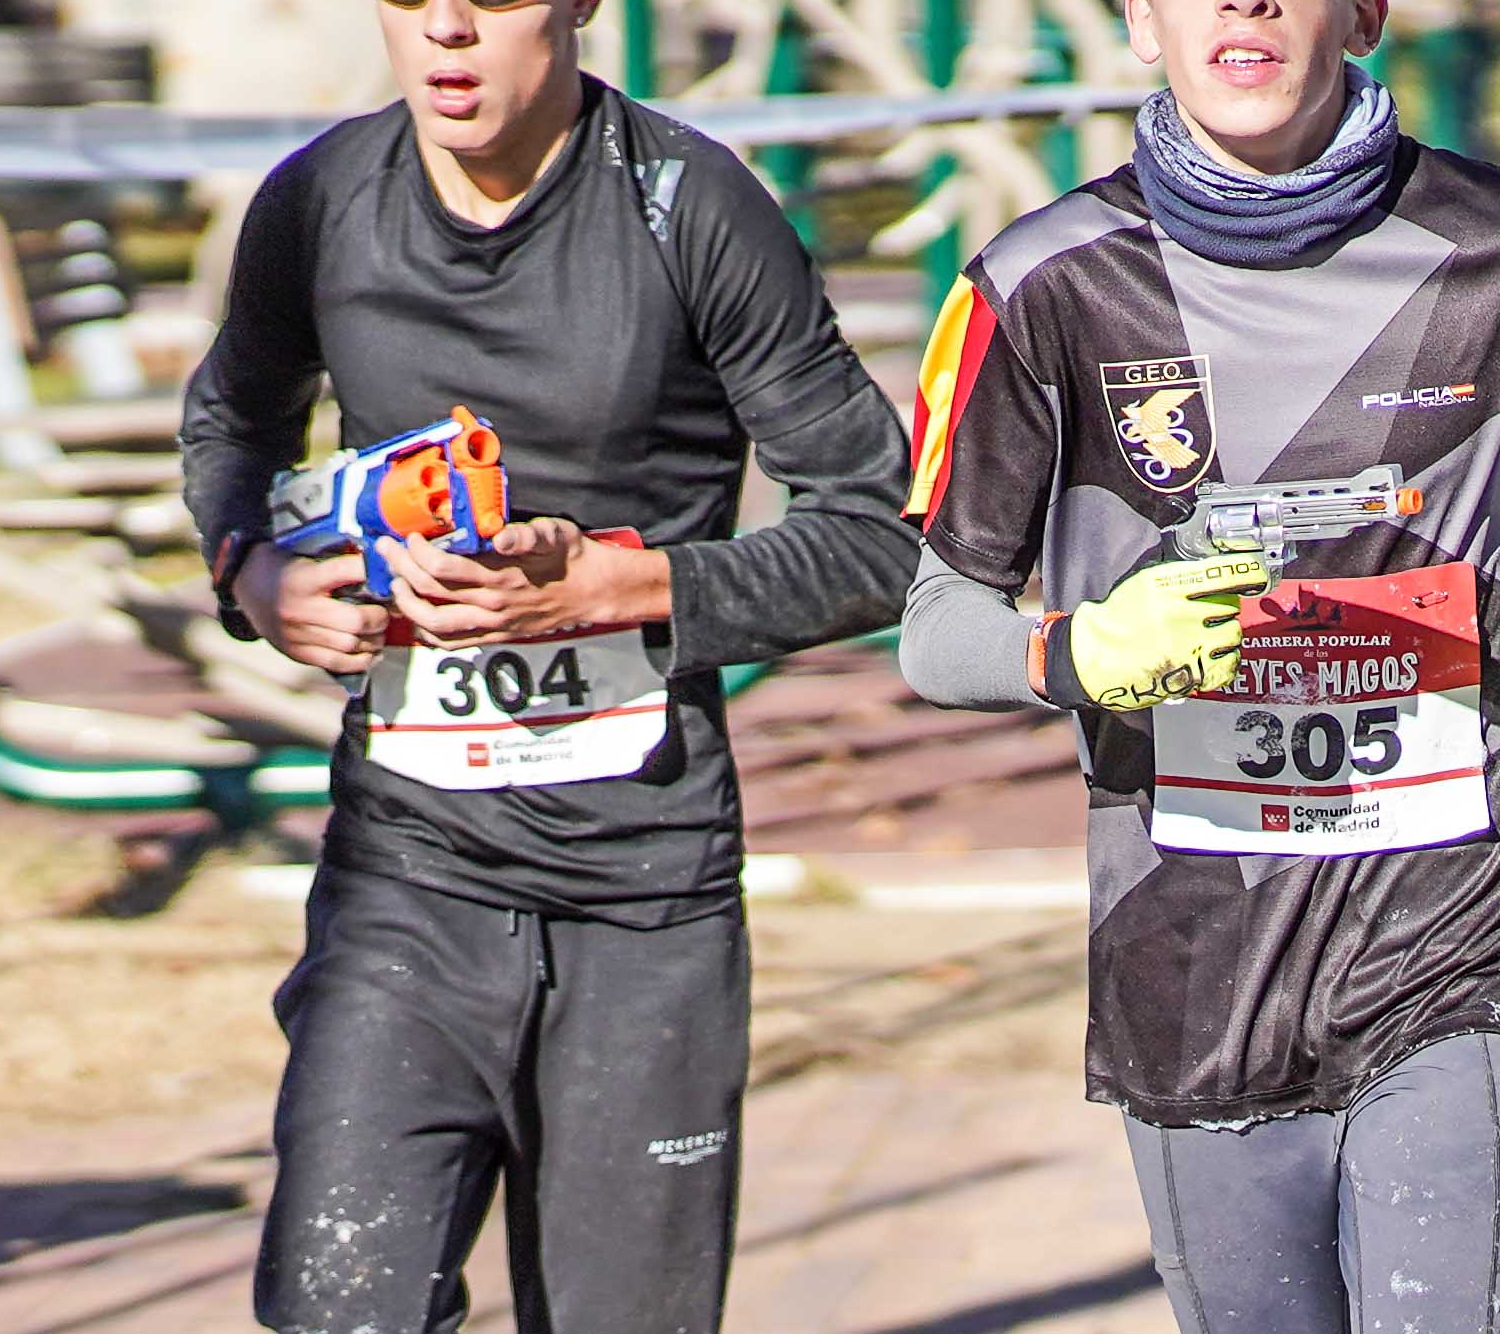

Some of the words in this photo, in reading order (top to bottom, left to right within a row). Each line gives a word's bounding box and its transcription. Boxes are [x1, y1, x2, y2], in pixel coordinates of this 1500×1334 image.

[1125, 363, 1184, 383] G.E.O.
[1362, 385, 1453, 409] POLICIA
[1419, 394, 1477, 408] NACIONAL
[1206, 561, 1260, 579] COLD
[1242, 636, 1314, 647] CARRERA
[1319, 635, 1391, 647] POPULAR
[437, 647, 591, 717] 304
[1217, 658, 1302, 695] EYES
[1317, 652, 1418, 698] MAGOS
[1234, 706, 1402, 782] 305
[1293, 801, 1380, 818] Comunidad
[1295, 821, 1315, 833] de
[1322, 817, 1380, 833] Madrid
